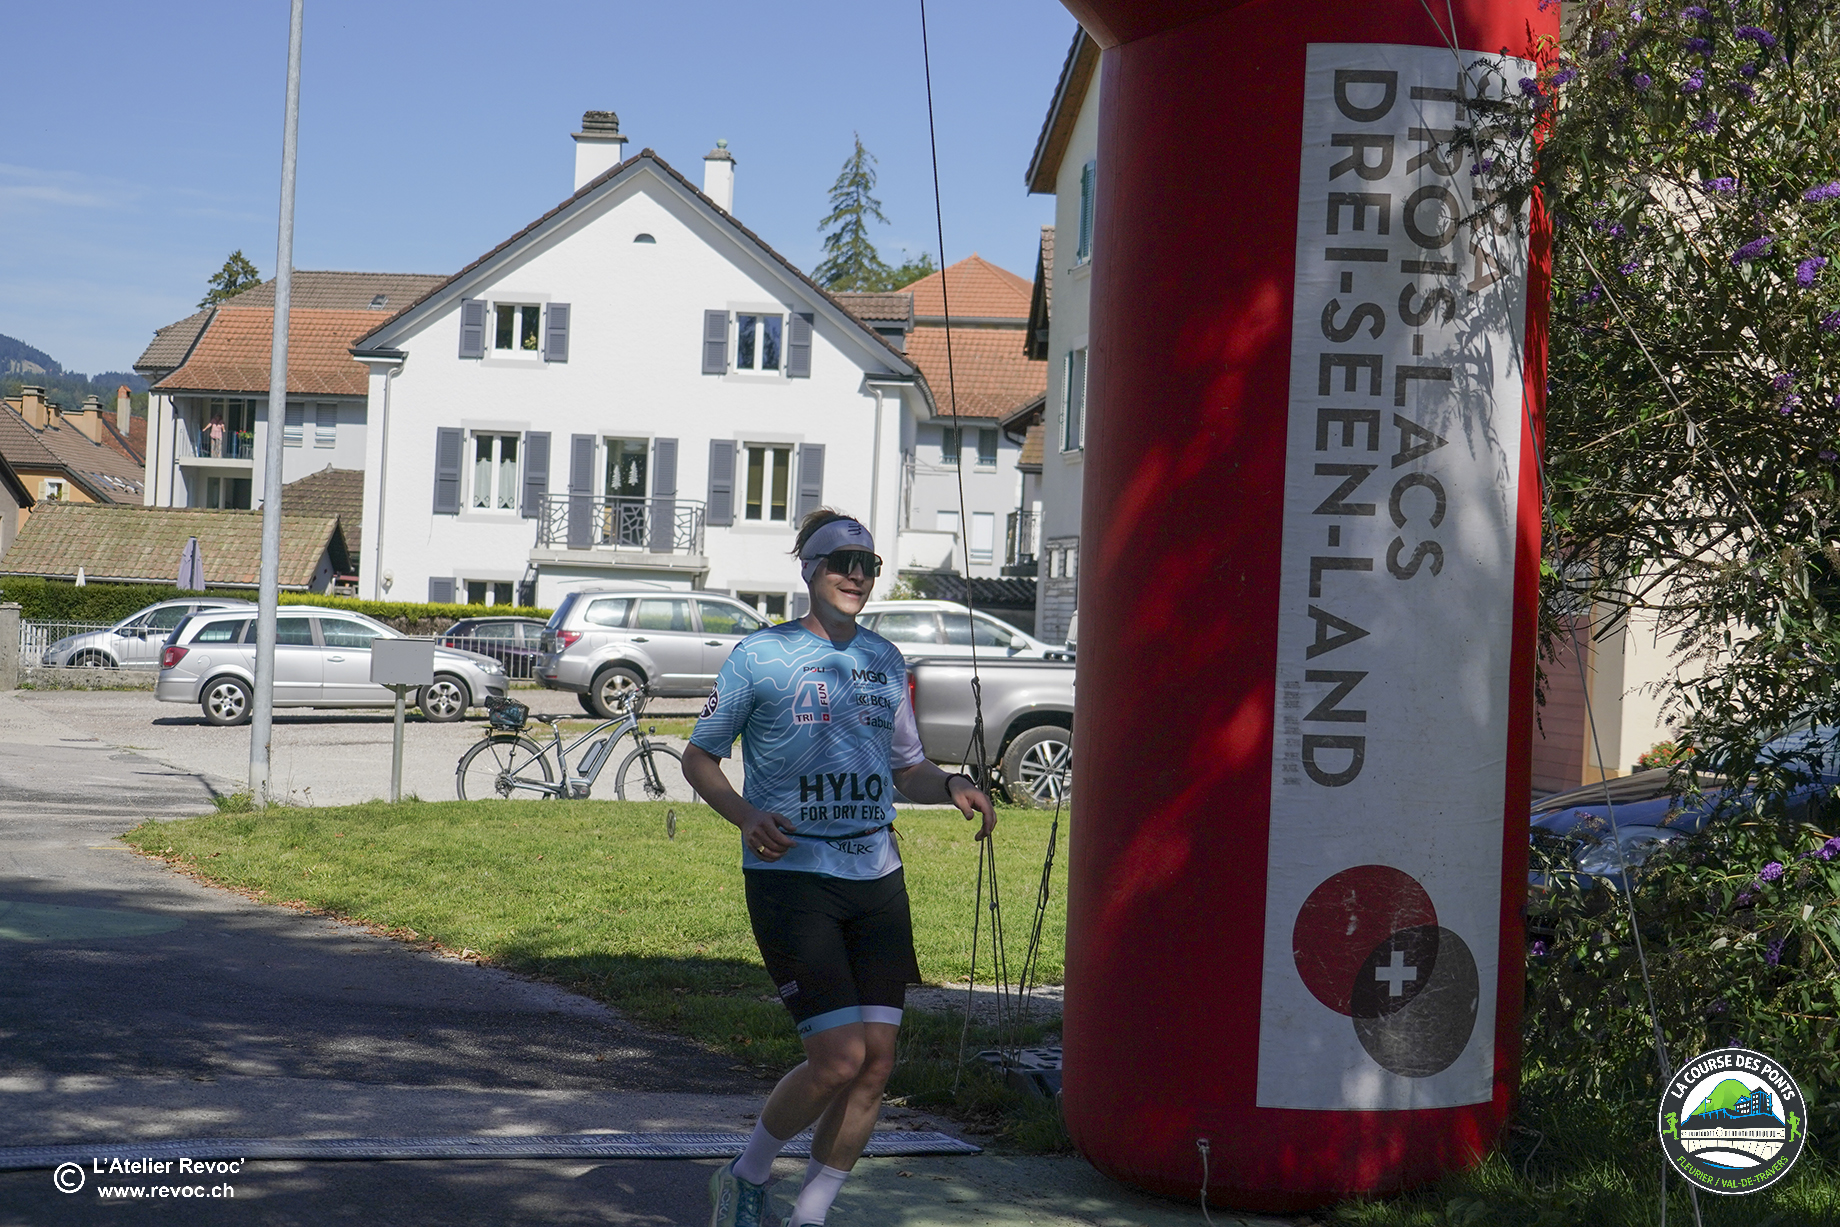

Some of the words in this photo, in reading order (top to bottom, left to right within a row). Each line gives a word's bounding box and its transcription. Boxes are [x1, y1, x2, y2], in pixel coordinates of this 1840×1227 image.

[1385, 71, 1467, 581] TROIS-LACS
[1302, 69, 1398, 787] DREI-SEEN-LAND
[851, 668, 888, 685] MGO
[817, 683, 828, 706] FUN
[870, 695, 891, 709] BCN
[795, 713, 813, 722] TRI
[800, 806, 828, 821] FOR
[833, 805, 857, 820] DRY
[862, 805, 886, 821] EYES
